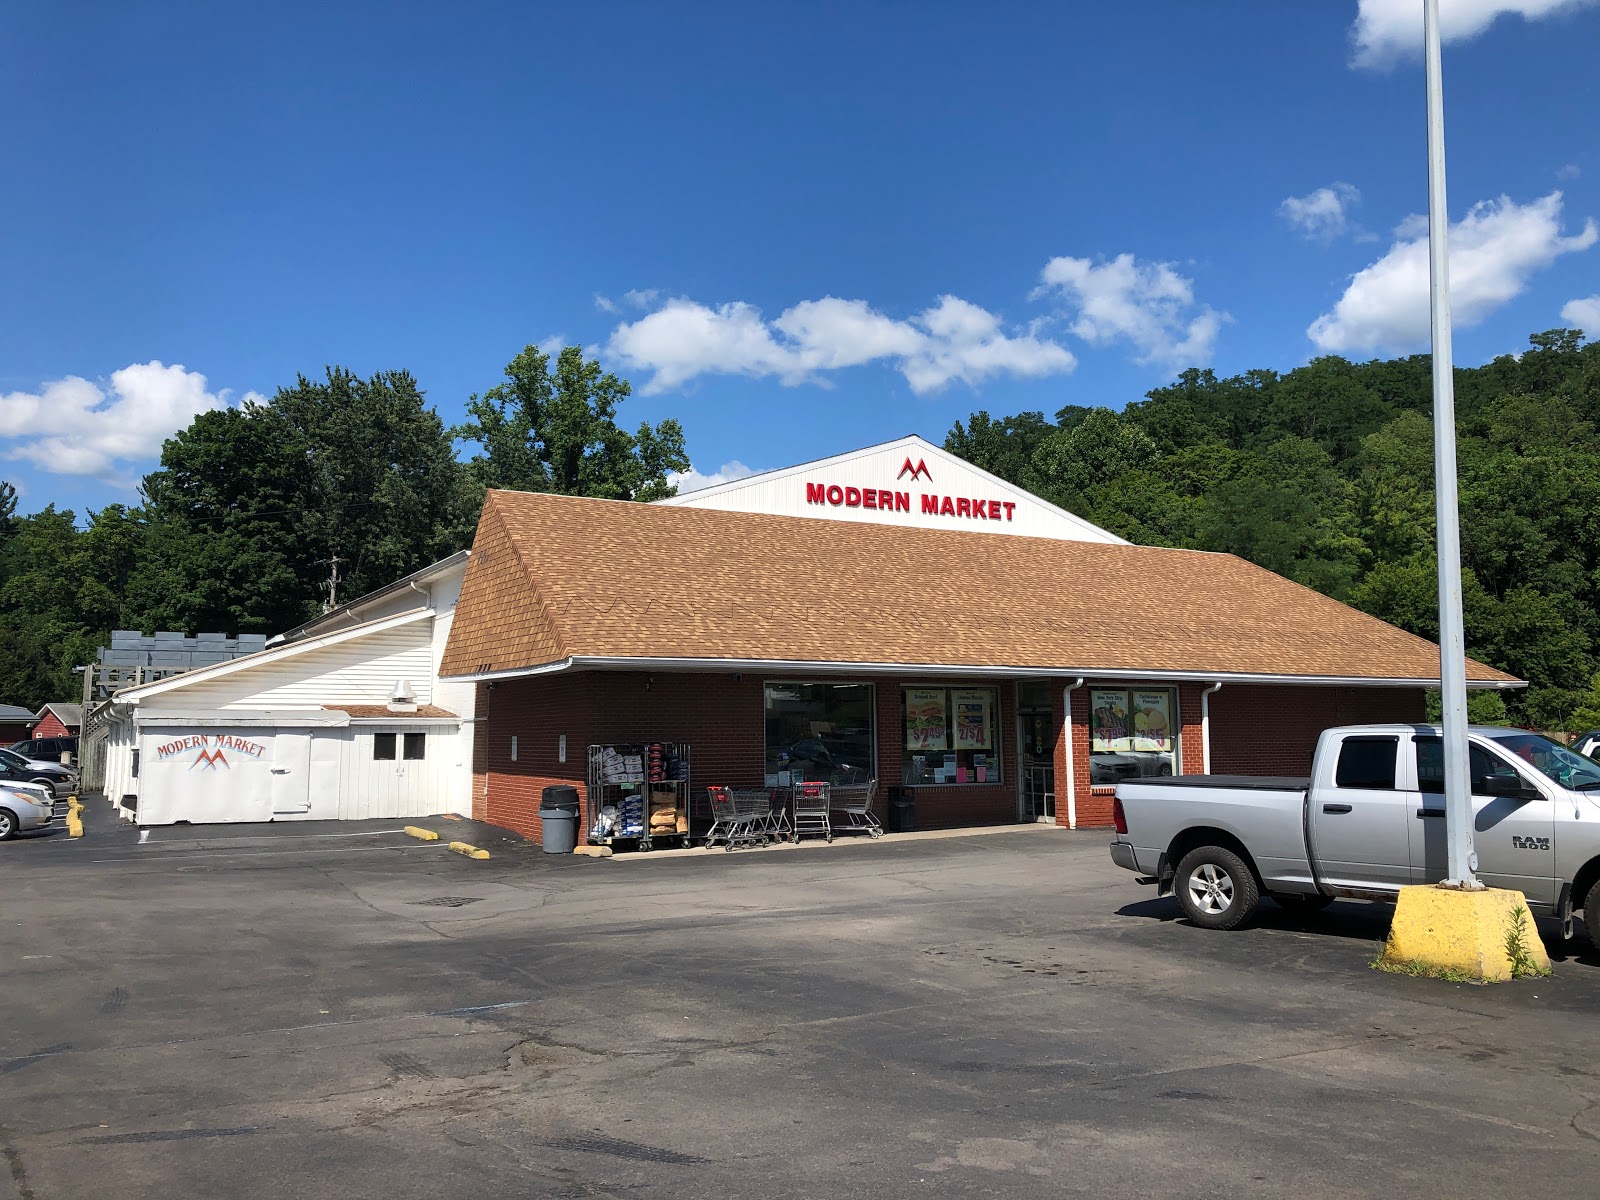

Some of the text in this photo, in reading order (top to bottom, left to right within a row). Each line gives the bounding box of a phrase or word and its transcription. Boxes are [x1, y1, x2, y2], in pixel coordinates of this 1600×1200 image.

[806, 482, 1016, 521] MODERN MARKET
[157, 735, 266, 759] MODERN MARKET
[1512, 835, 1550, 844] RAM
[1512, 842, 1550, 851] 1500
